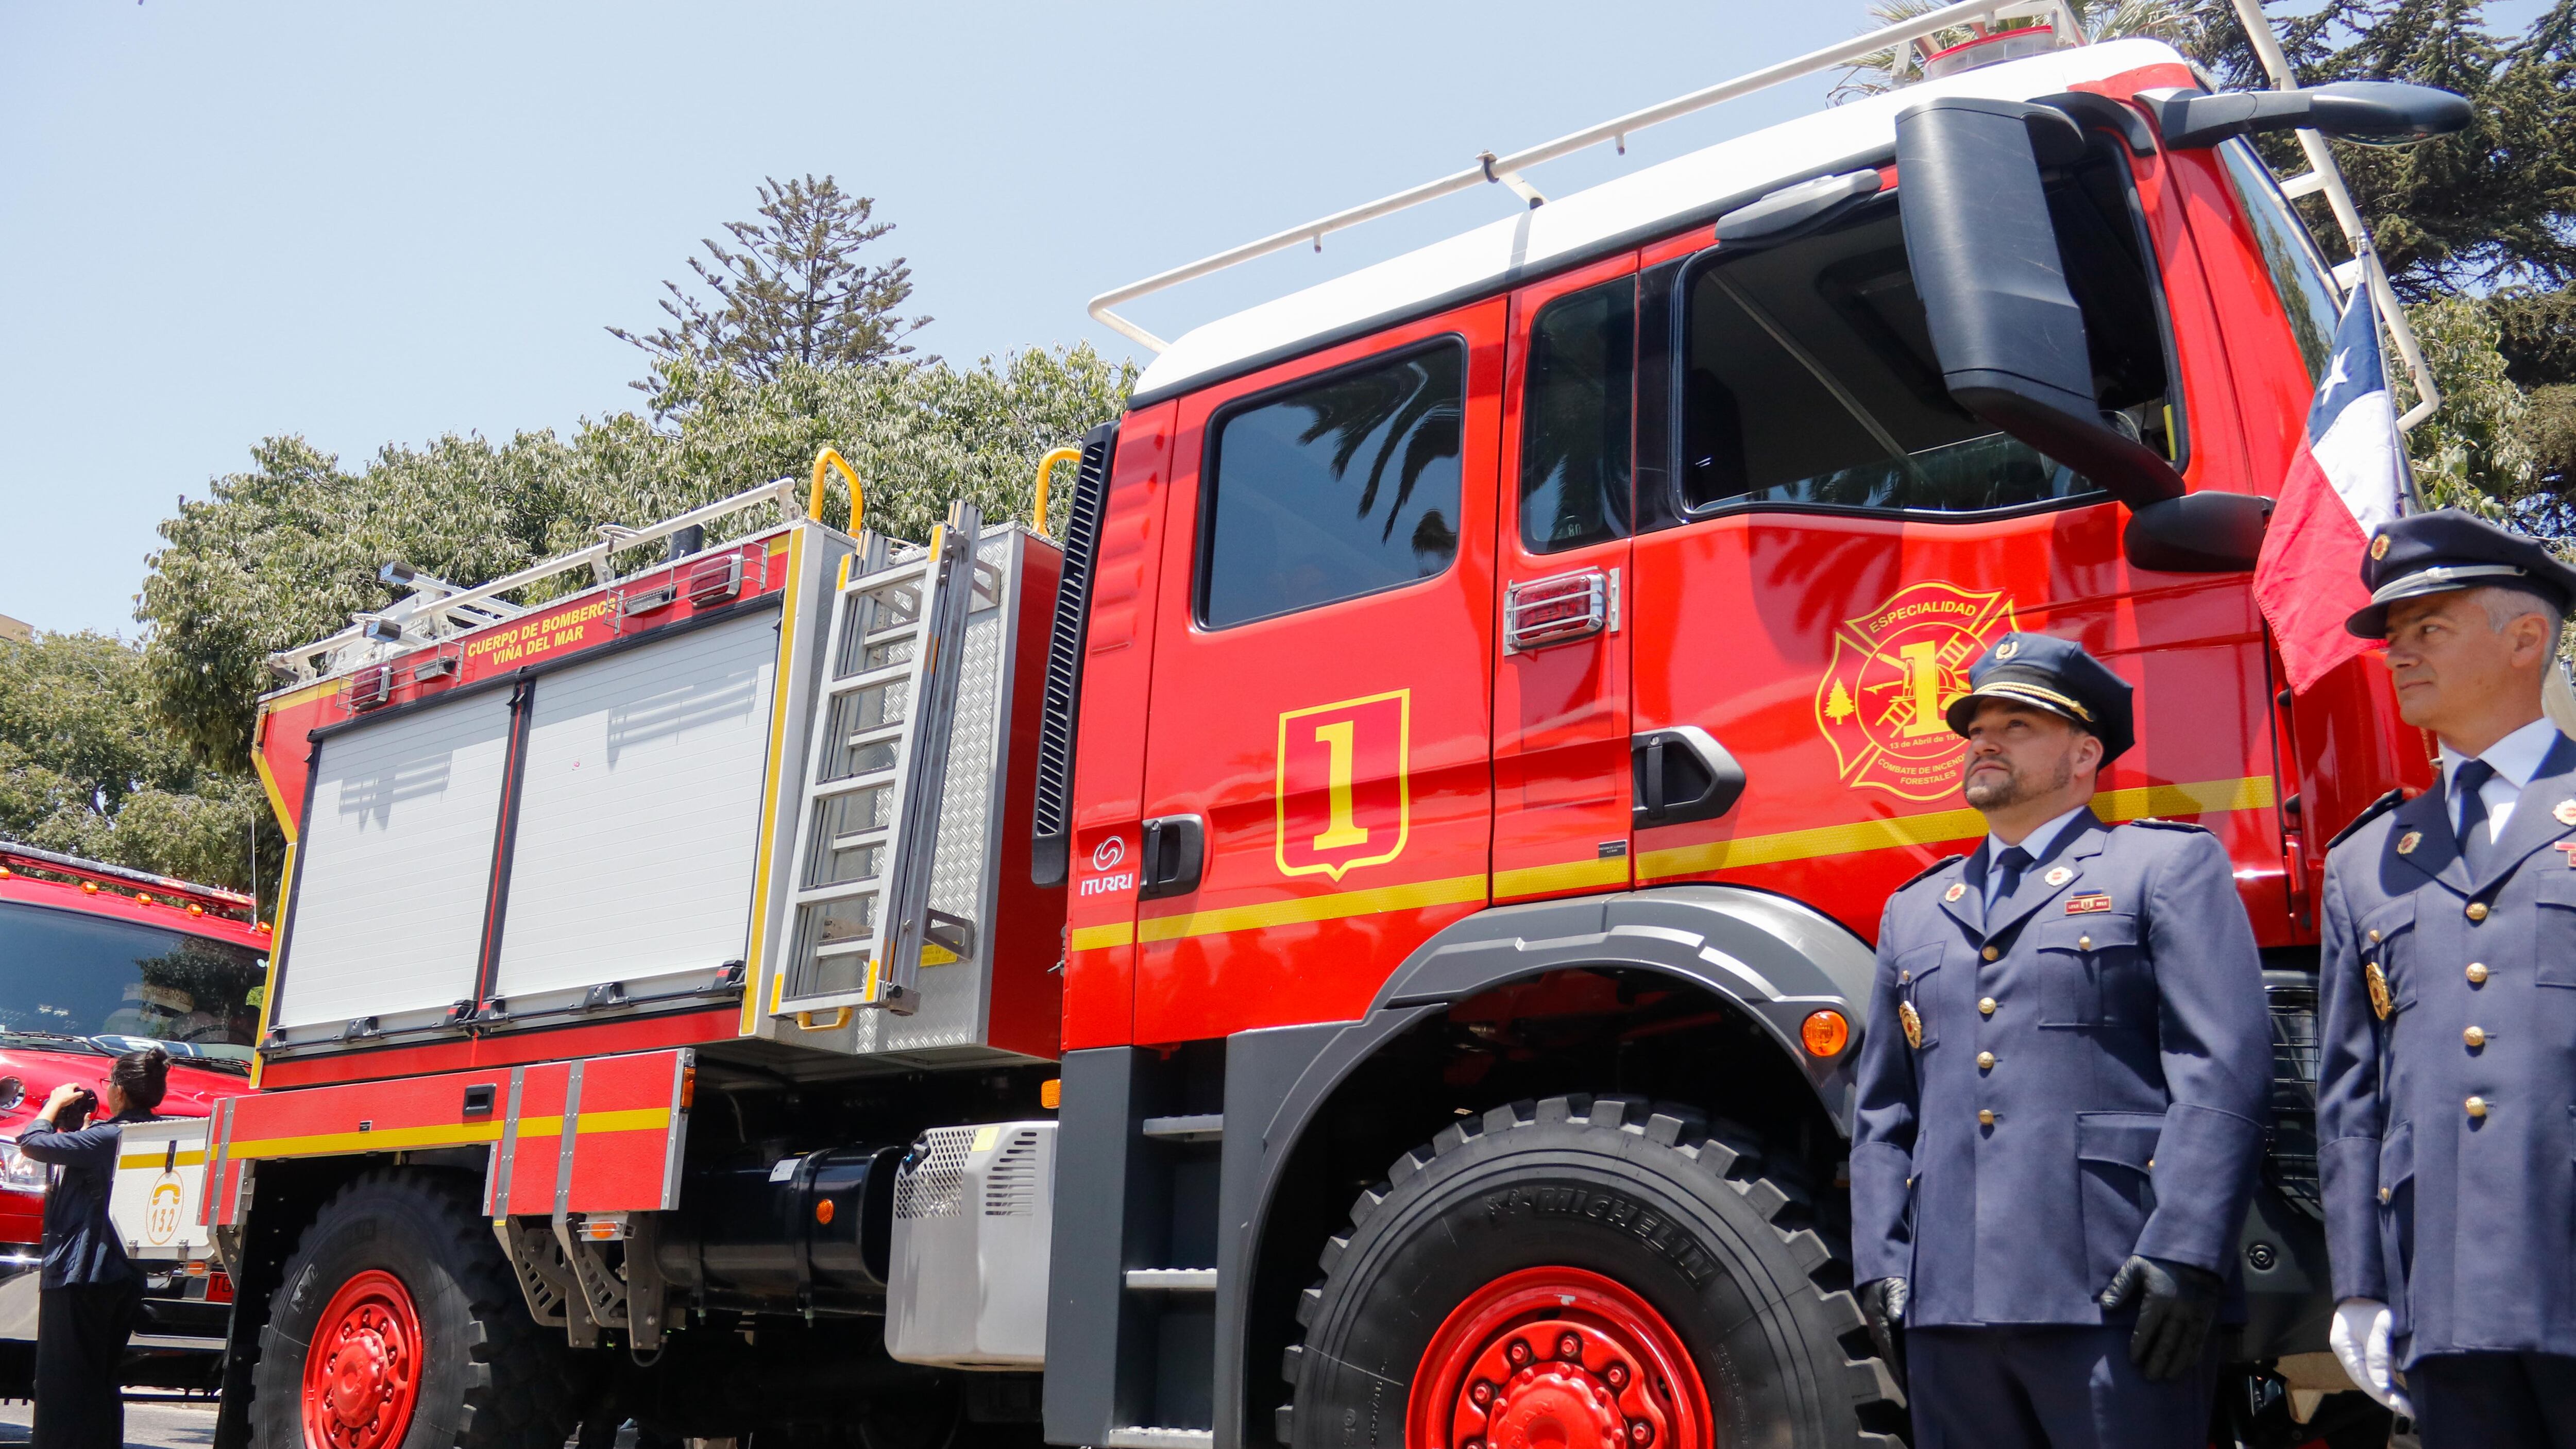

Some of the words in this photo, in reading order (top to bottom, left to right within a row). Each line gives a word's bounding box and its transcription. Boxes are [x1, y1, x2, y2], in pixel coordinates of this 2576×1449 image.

[467, 629, 518, 657] CUERPO
[521, 622, 538, 640] DE
[541, 598, 616, 634] BOMBEROS
[1868, 601, 1977, 634] ESPECIALIDAD
[493, 643, 522, 666] VIÑA
[526, 636, 550, 656] DEL
[554, 625, 584, 647] MAR
[1900, 640, 1955, 738] 1
[1912, 737, 1931, 746] Abril
[1945, 733, 1964, 741] 191
[1877, 758, 1917, 775] COMBATE
[1932, 753, 1965, 772] INCEND
[1900, 770, 1957, 785] FORESTALES
[1313, 720, 1368, 851] 1
[1080, 872, 1133, 896] ITURRI
[152, 1207, 175, 1232] 132
[1538, 1187, 1715, 1282] MICHELIN
